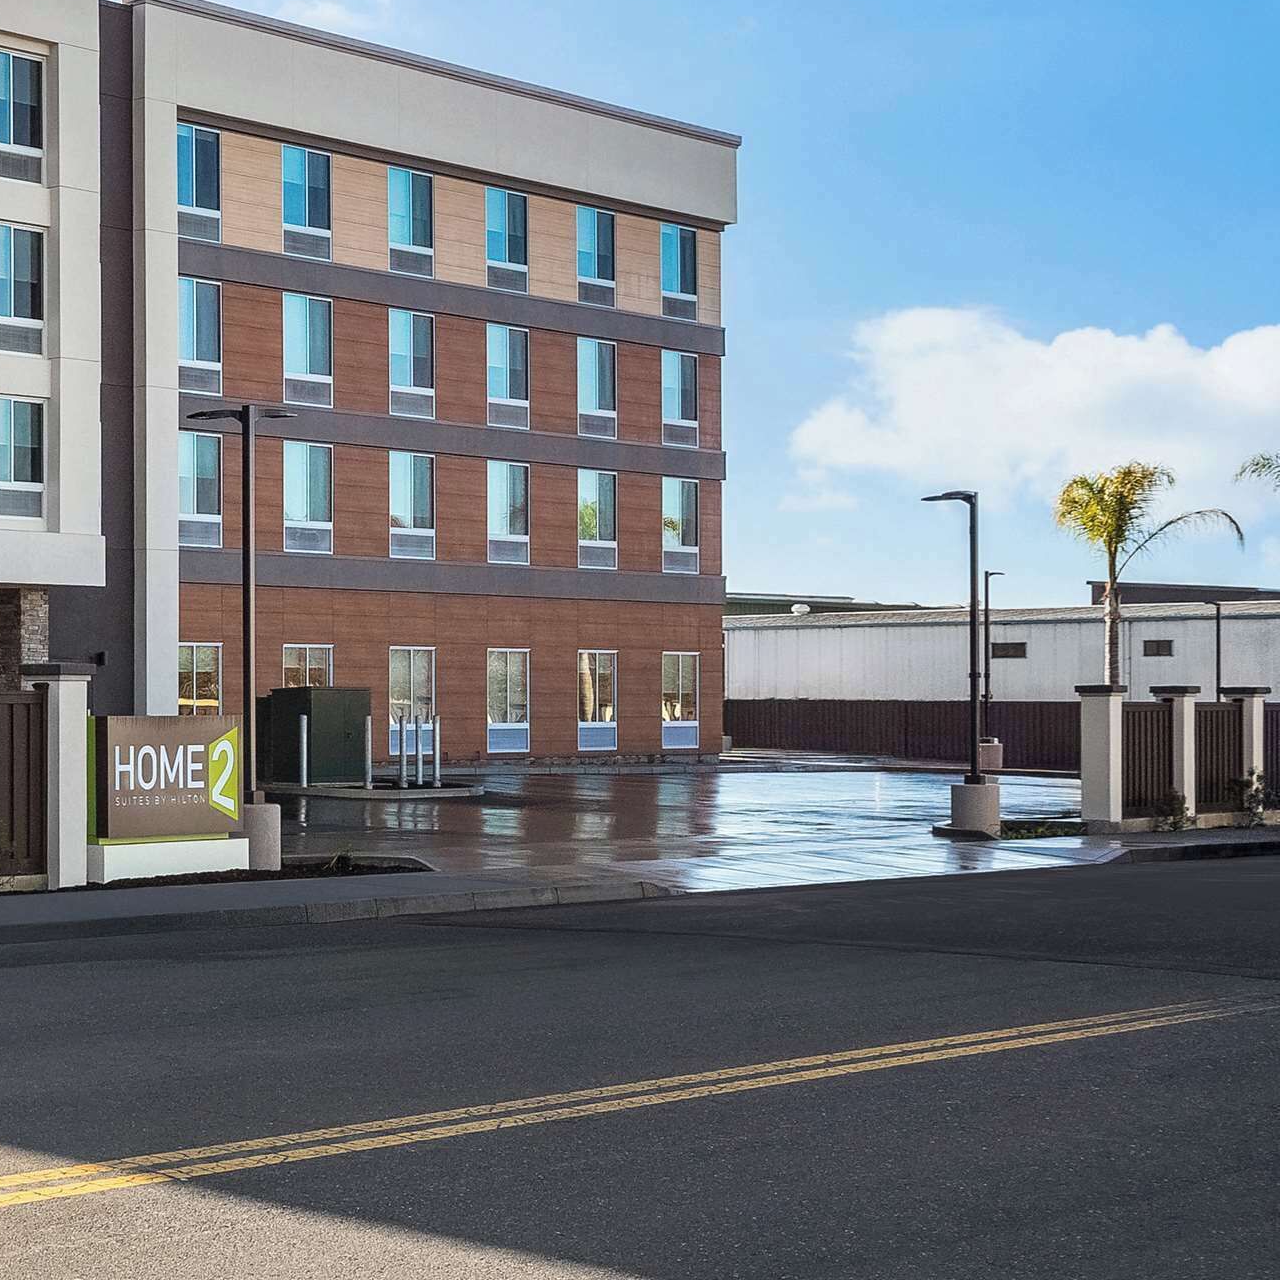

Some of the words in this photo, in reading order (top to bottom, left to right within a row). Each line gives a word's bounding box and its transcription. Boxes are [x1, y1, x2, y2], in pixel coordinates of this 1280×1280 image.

[114, 744, 205, 791] HOME
[211, 739, 235, 813] 2
[114, 795, 151, 807] SUITES
[154, 795, 167, 806] BY
[170, 793, 206, 805] HILTON
